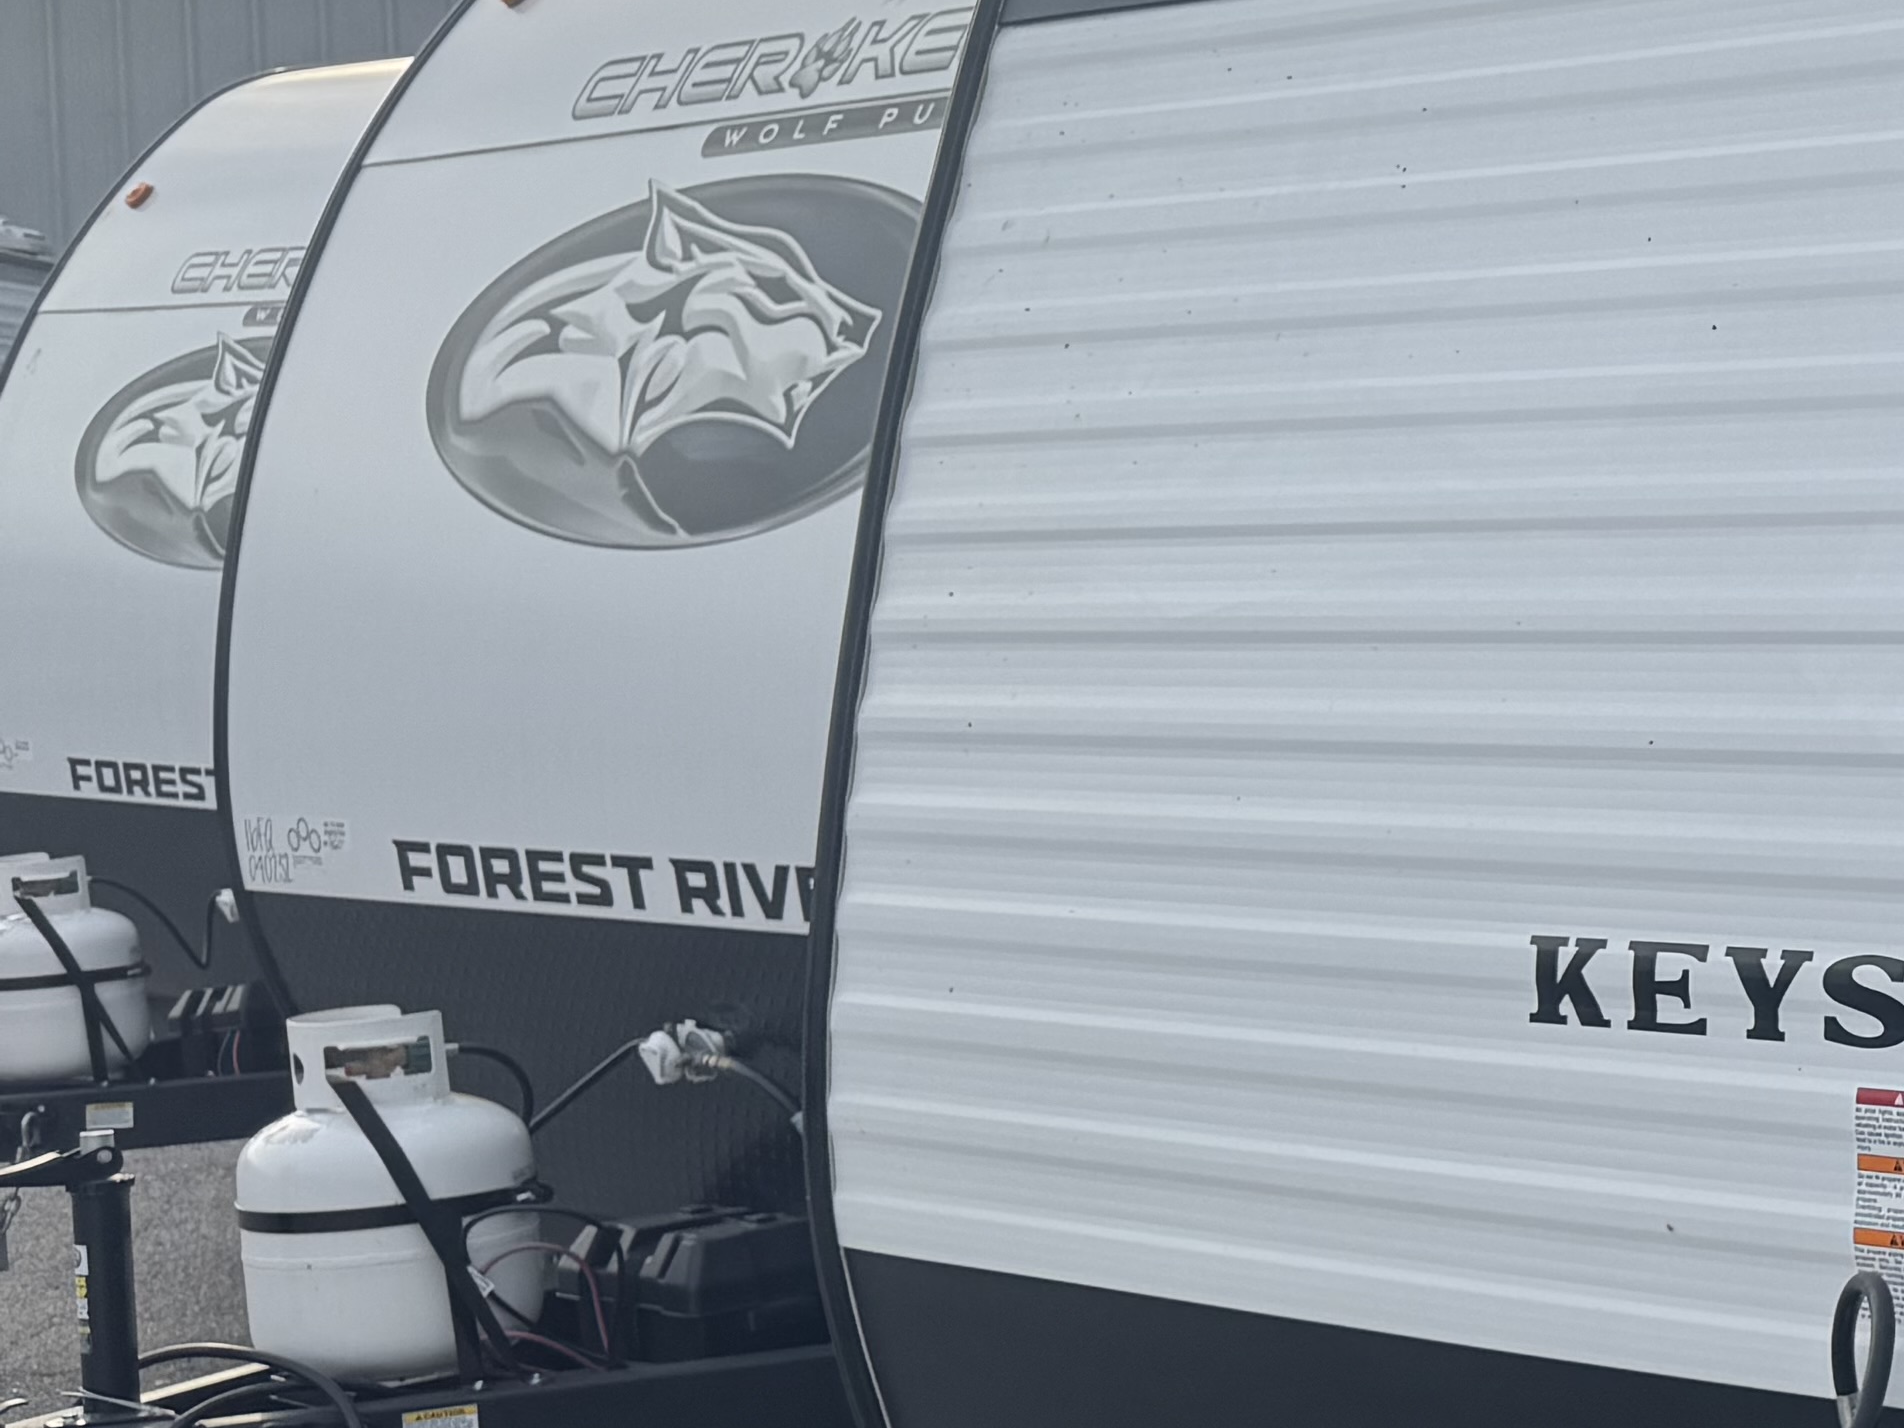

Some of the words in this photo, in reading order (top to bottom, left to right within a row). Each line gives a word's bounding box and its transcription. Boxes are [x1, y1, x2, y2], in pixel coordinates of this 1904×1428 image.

[724, 114, 843, 148] WOLF
[879, 102, 936, 129] PU
[67, 757, 214, 801] FORES
[392, 839, 653, 910] FOREST
